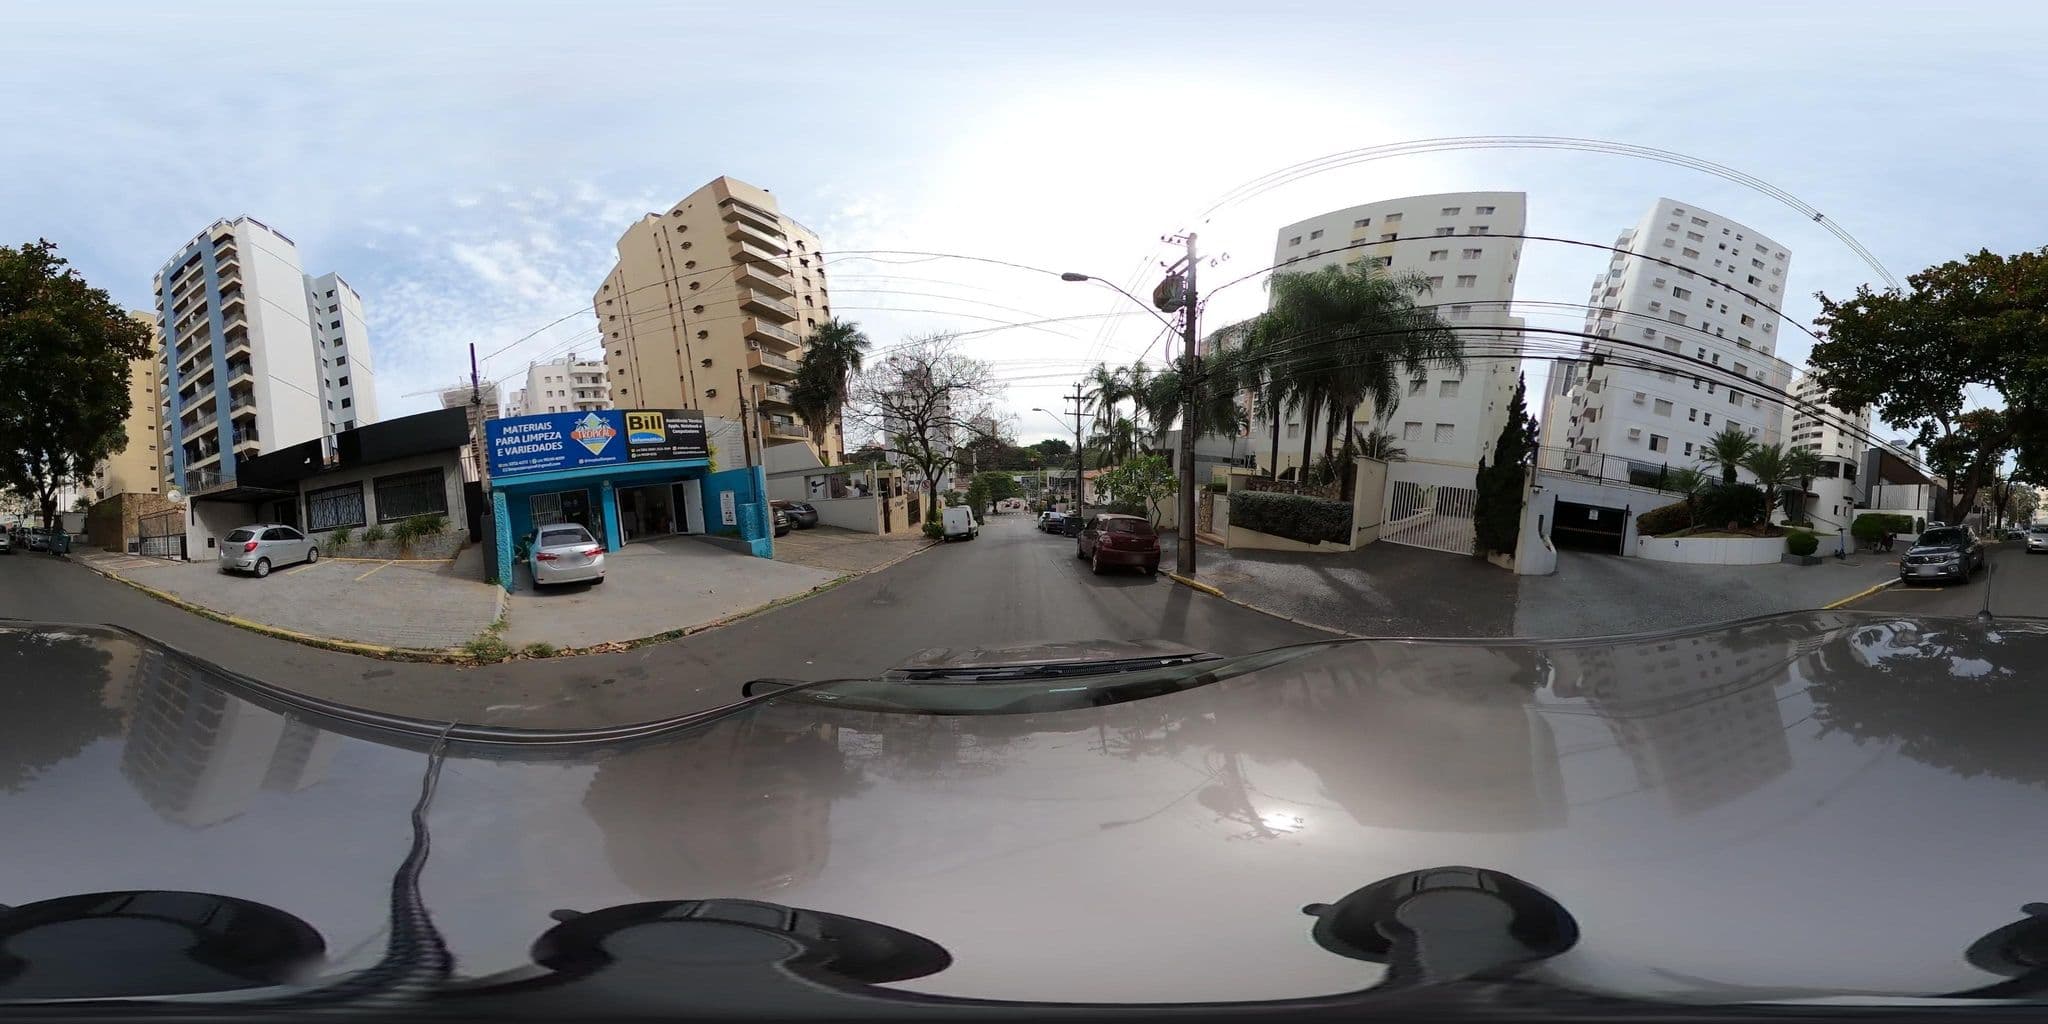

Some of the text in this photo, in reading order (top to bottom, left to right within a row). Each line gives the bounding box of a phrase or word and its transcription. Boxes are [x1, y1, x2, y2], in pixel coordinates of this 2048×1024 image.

[502, 421, 552, 435] MATERIAIS
[628, 415, 662, 430] Bill
[495, 431, 562, 446] PARA LIMPEZA
[578, 428, 609, 439] TROPICAL
[497, 442, 563, 457] E VARIEDADES
